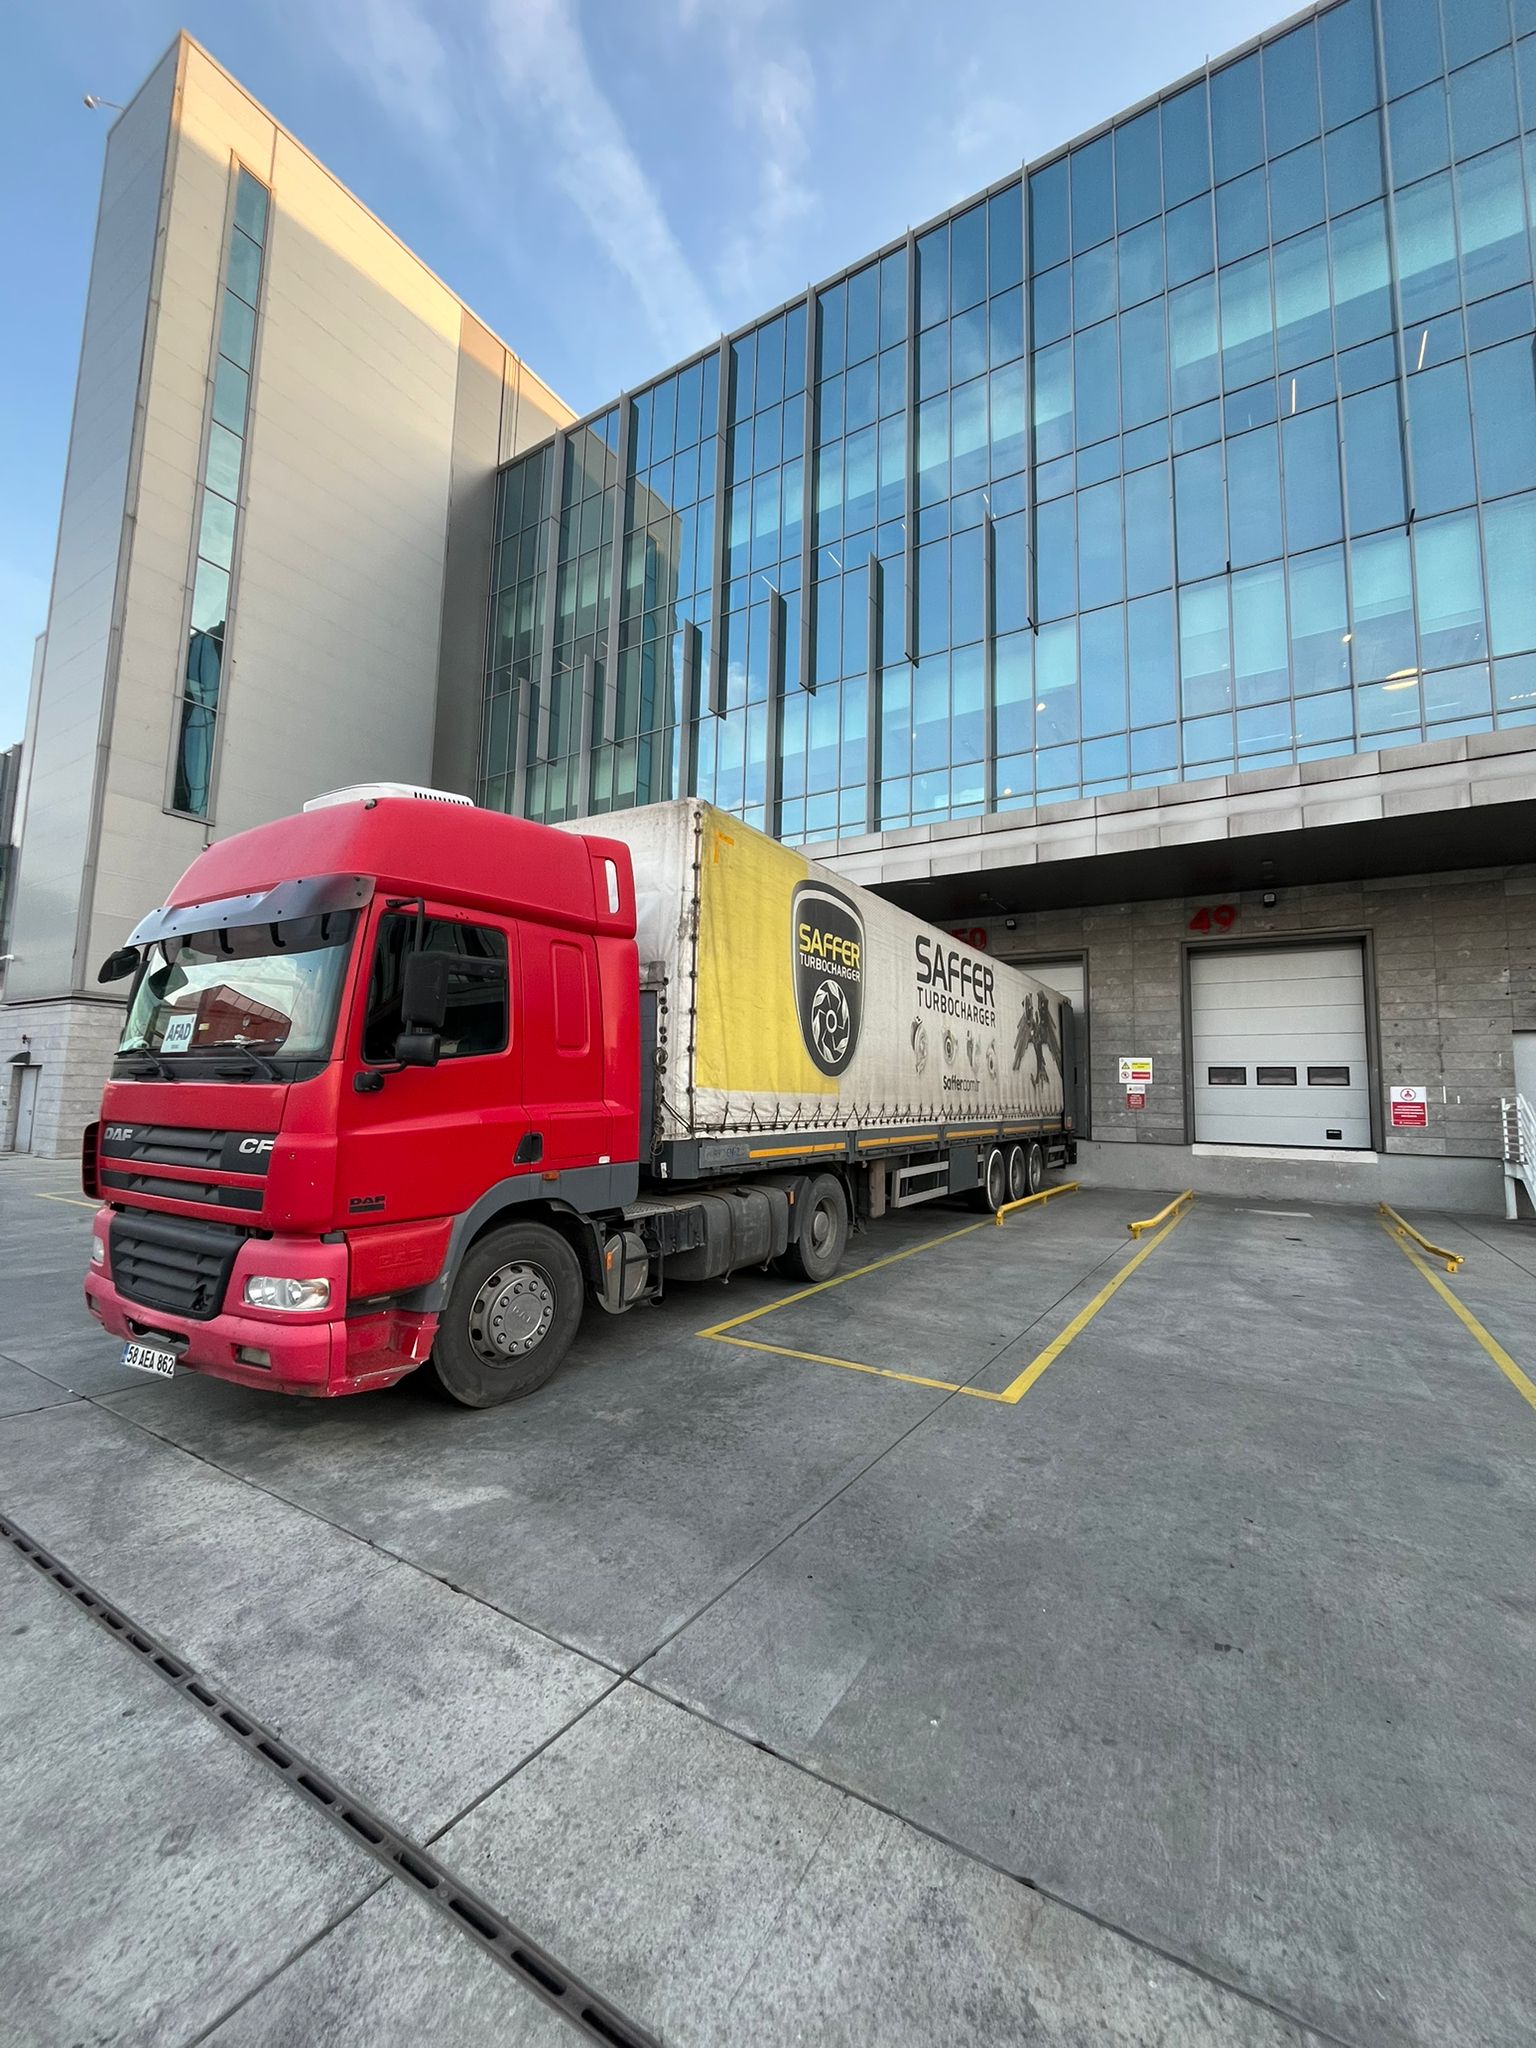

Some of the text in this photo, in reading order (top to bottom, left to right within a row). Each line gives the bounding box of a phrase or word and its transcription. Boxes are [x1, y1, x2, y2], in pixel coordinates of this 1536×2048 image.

[1189, 905, 1236, 935] 49
[799, 923, 860, 969] SAFFER
[800, 952, 860, 983] TURBOCHARGER
[915, 934, 995, 1008] SAFFER
[917, 986, 996, 1028] TURBOCHARGER
[166, 1022, 192, 1041] AFAD
[104, 1127, 133, 1141] DAF
[238, 1138, 274, 1154] CF
[350, 1195, 385, 1205] DAF
[126, 1345, 174, 1375] 58 AEA 862
